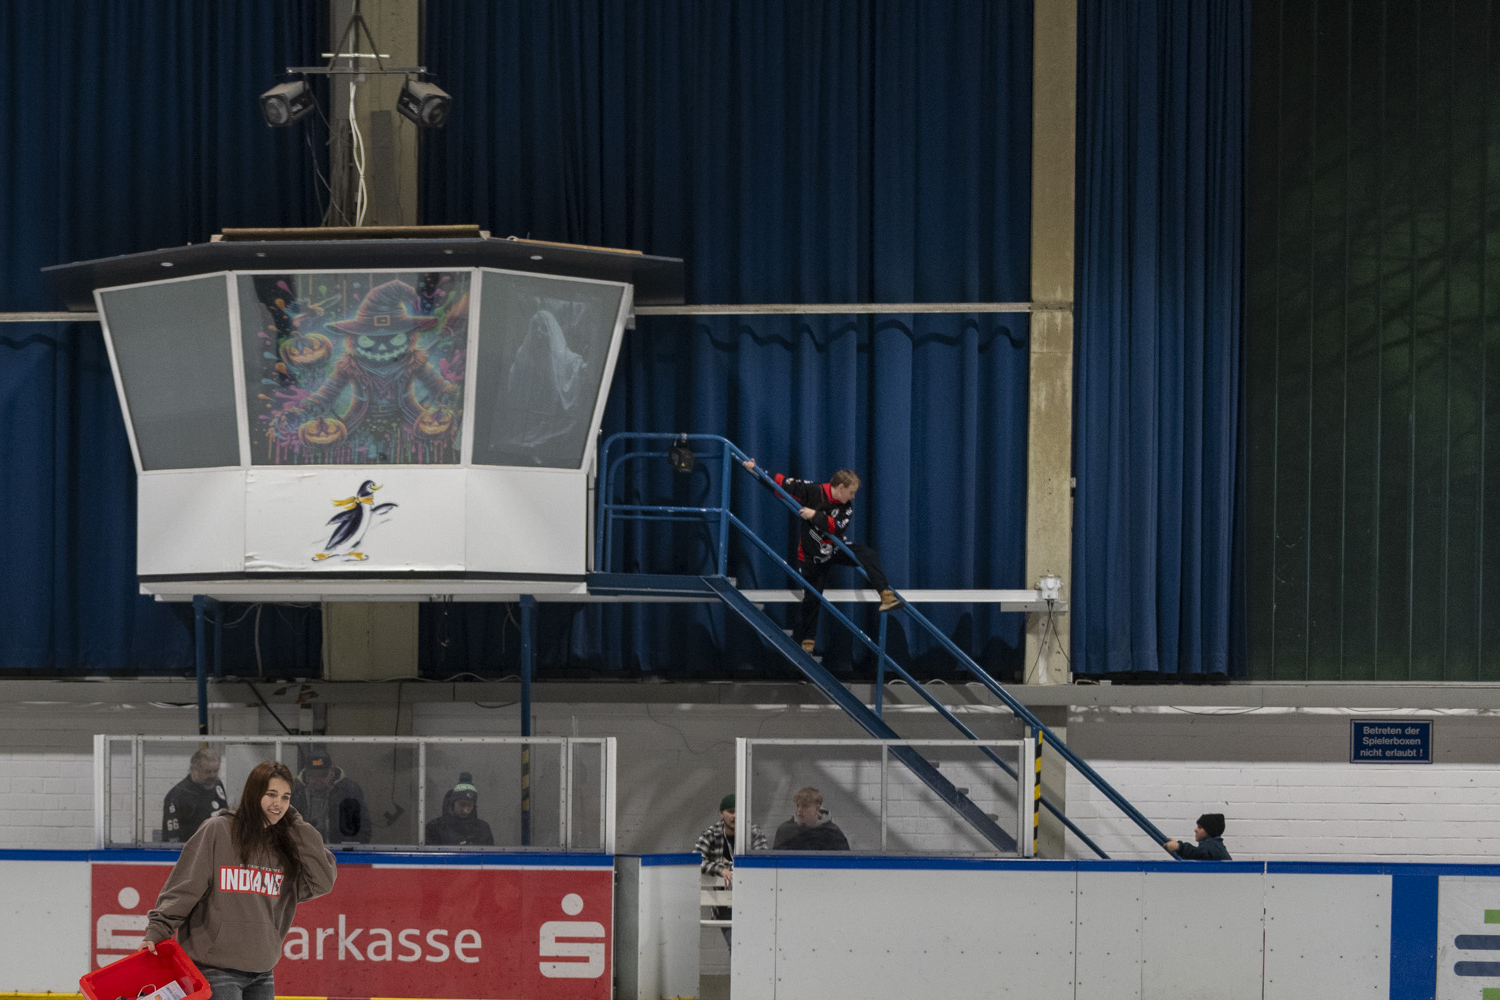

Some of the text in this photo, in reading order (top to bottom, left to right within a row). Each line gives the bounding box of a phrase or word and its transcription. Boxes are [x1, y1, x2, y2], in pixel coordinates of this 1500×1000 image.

[1363, 726, 1420, 735] Betreten der
[1362, 736, 1421, 746] Spielerboxen
[1360, 748, 1382, 757] nicht
[1385, 748, 1417, 757] erlaubt
[284, 914, 483, 963] arkasse
